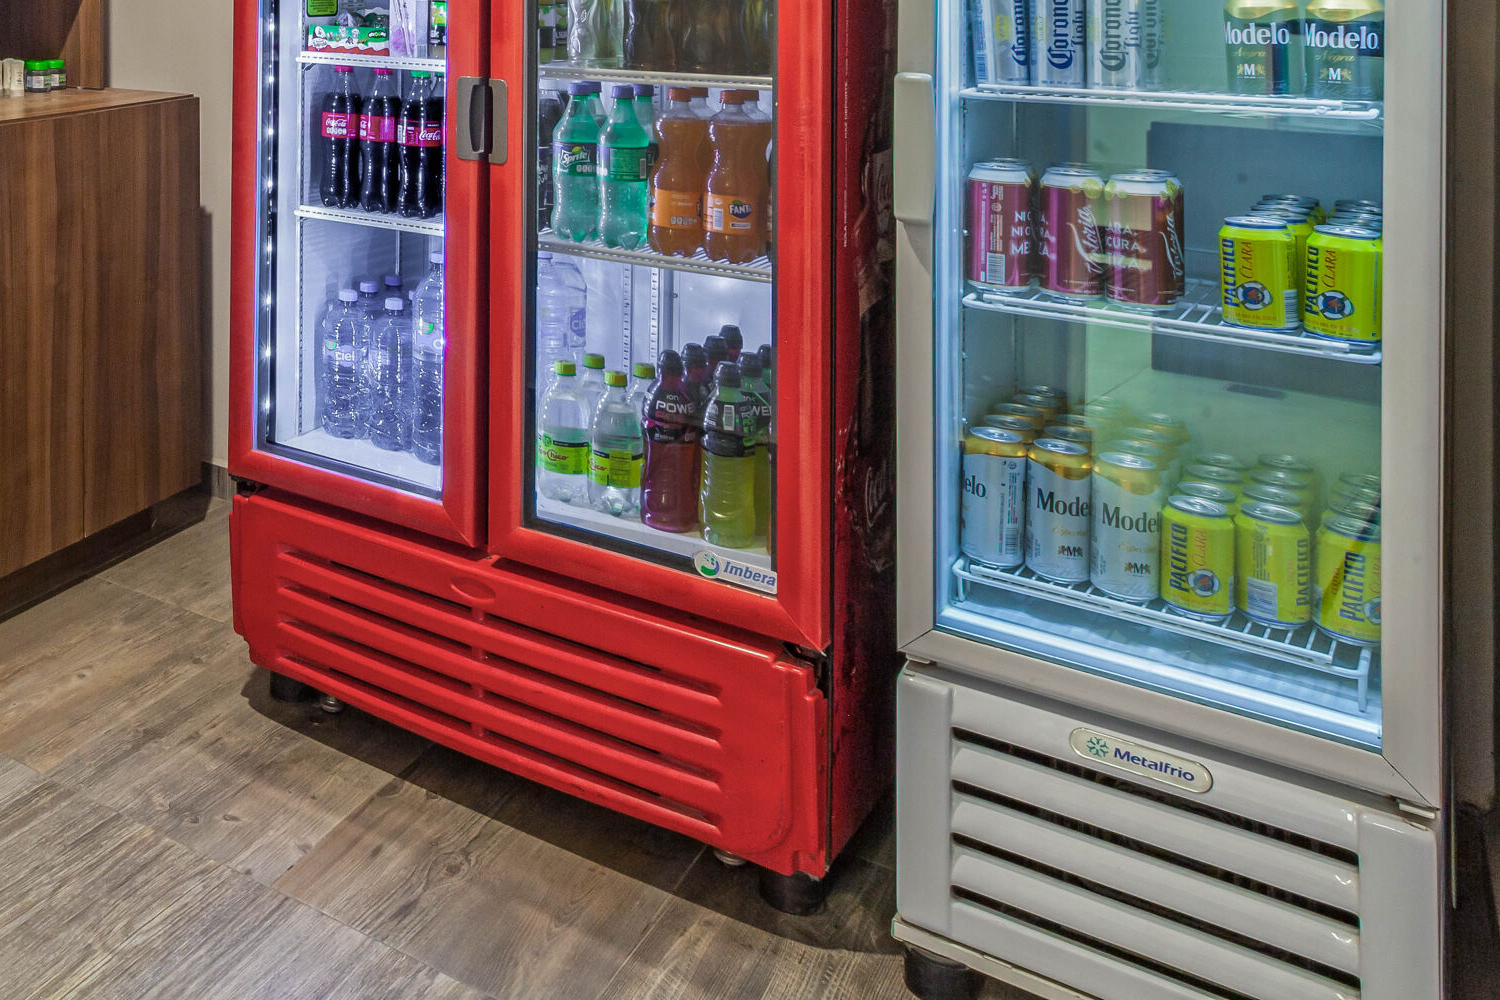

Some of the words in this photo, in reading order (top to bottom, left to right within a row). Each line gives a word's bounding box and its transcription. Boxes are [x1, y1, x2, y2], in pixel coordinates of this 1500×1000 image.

[1244, 64, 1255, 75] M
[1329, 68, 1341, 80] M
[562, 151, 588, 164] Sprite
[1222, 239, 1240, 307] PACIFICO
[1239, 242, 1254, 279] CLARA
[1322, 250, 1338, 288] CLARA
[1305, 246, 1319, 316] PACIFICO
[1169, 523, 1189, 593] PACIFICO
[1192, 529, 1207, 566] CLARA
[724, 561, 776, 586] Imbera
[1339, 552, 1366, 623] PACIFICO
[1114, 748, 1195, 782] Metalfrio
